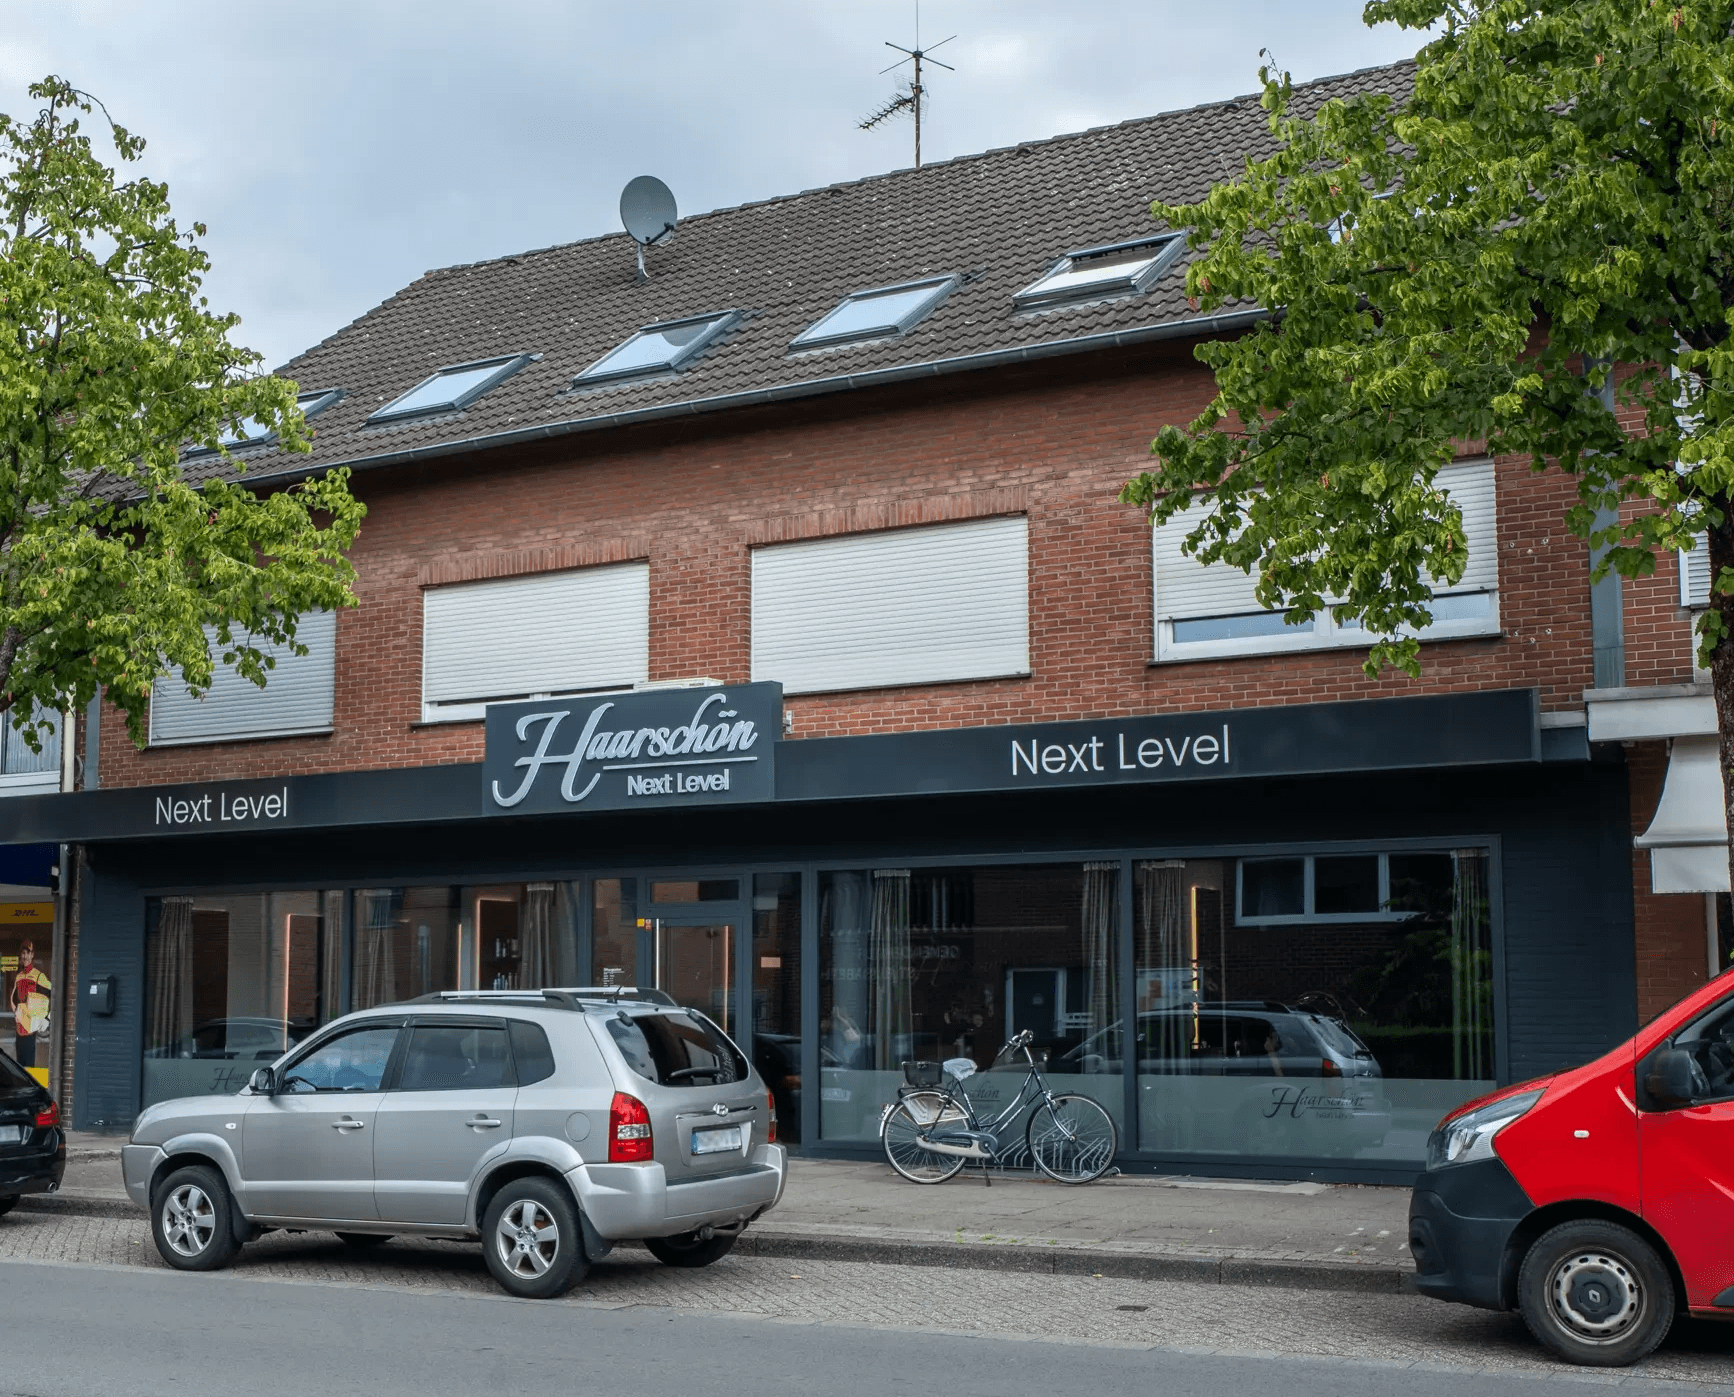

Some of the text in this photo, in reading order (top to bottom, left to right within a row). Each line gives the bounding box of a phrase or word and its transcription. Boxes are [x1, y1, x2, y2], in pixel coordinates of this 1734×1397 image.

[492, 693, 758, 807] Haarschön
[1012, 724, 1230, 776] Next Level
[627, 768, 731, 796] Next Level
[156, 786, 287, 825] Next Level
